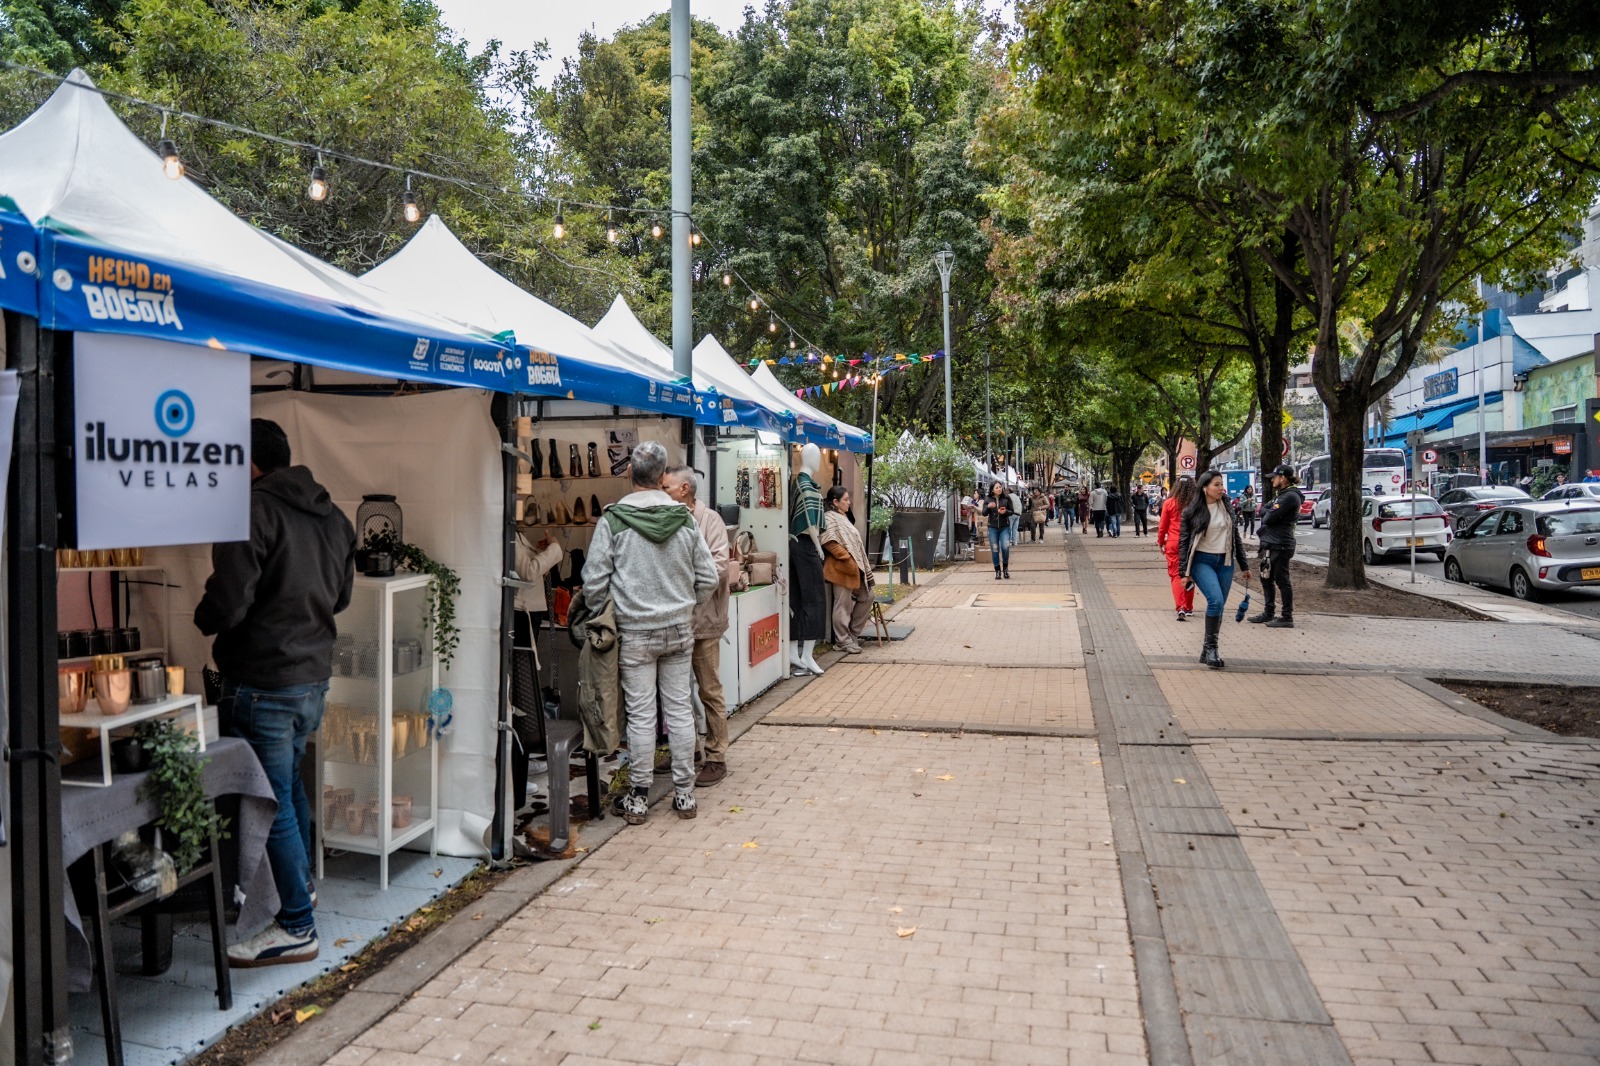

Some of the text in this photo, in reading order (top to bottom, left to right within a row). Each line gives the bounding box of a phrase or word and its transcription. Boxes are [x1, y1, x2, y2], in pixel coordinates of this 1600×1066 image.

[88, 255, 150, 289] HECHO
[81, 284, 184, 331] BOGOTÁ
[85, 421, 245, 466] ilumizen
[119, 470, 218, 488] VELAS
